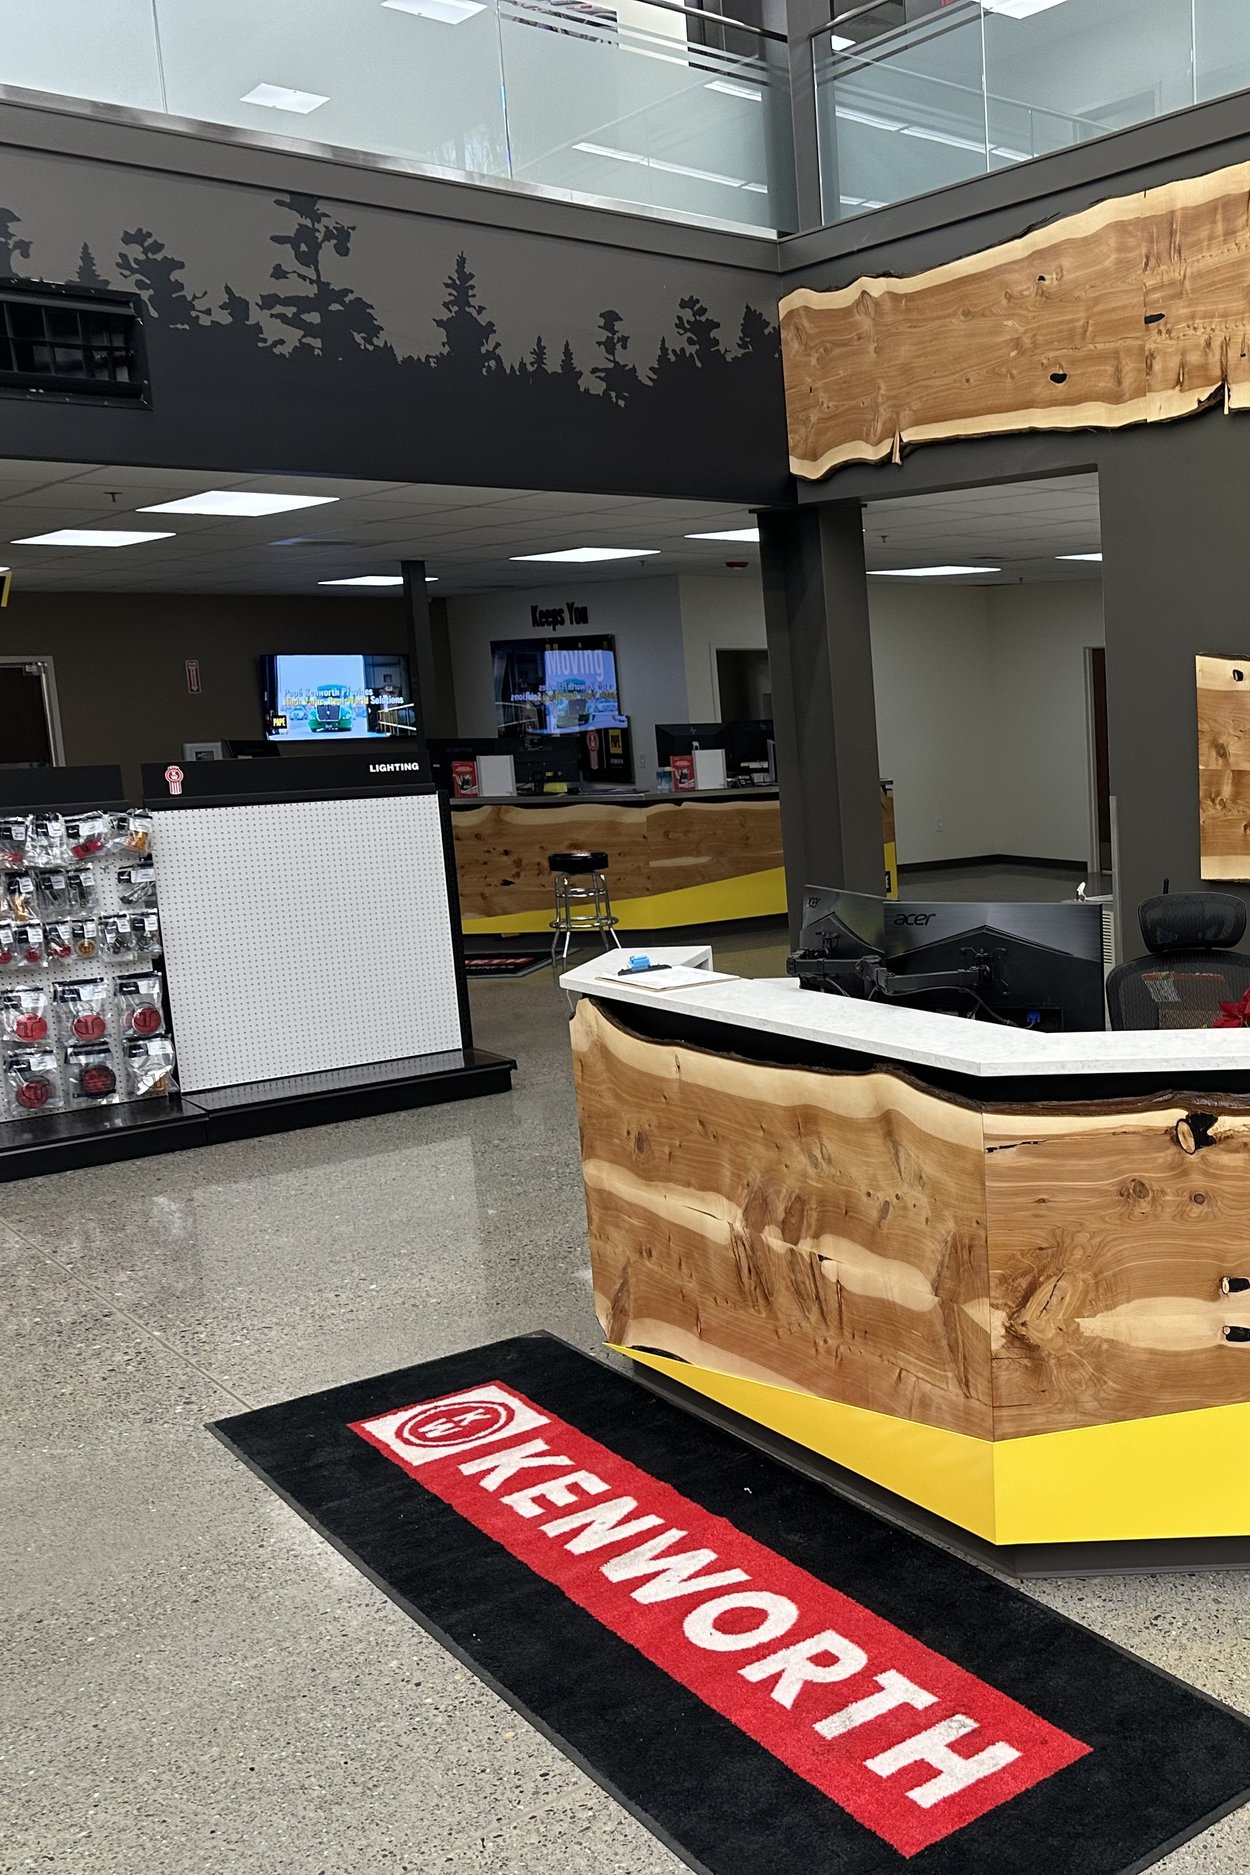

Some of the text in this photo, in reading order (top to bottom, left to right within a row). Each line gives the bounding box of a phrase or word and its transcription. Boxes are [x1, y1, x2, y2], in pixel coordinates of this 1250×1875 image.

[530, 602, 589, 631] Keeps You
[545, 642, 604, 681] Moving
[369, 762, 420, 773] LIGHTING
[894, 913, 937, 926] acer
[457, 1438, 1022, 1809] KENWORTH
